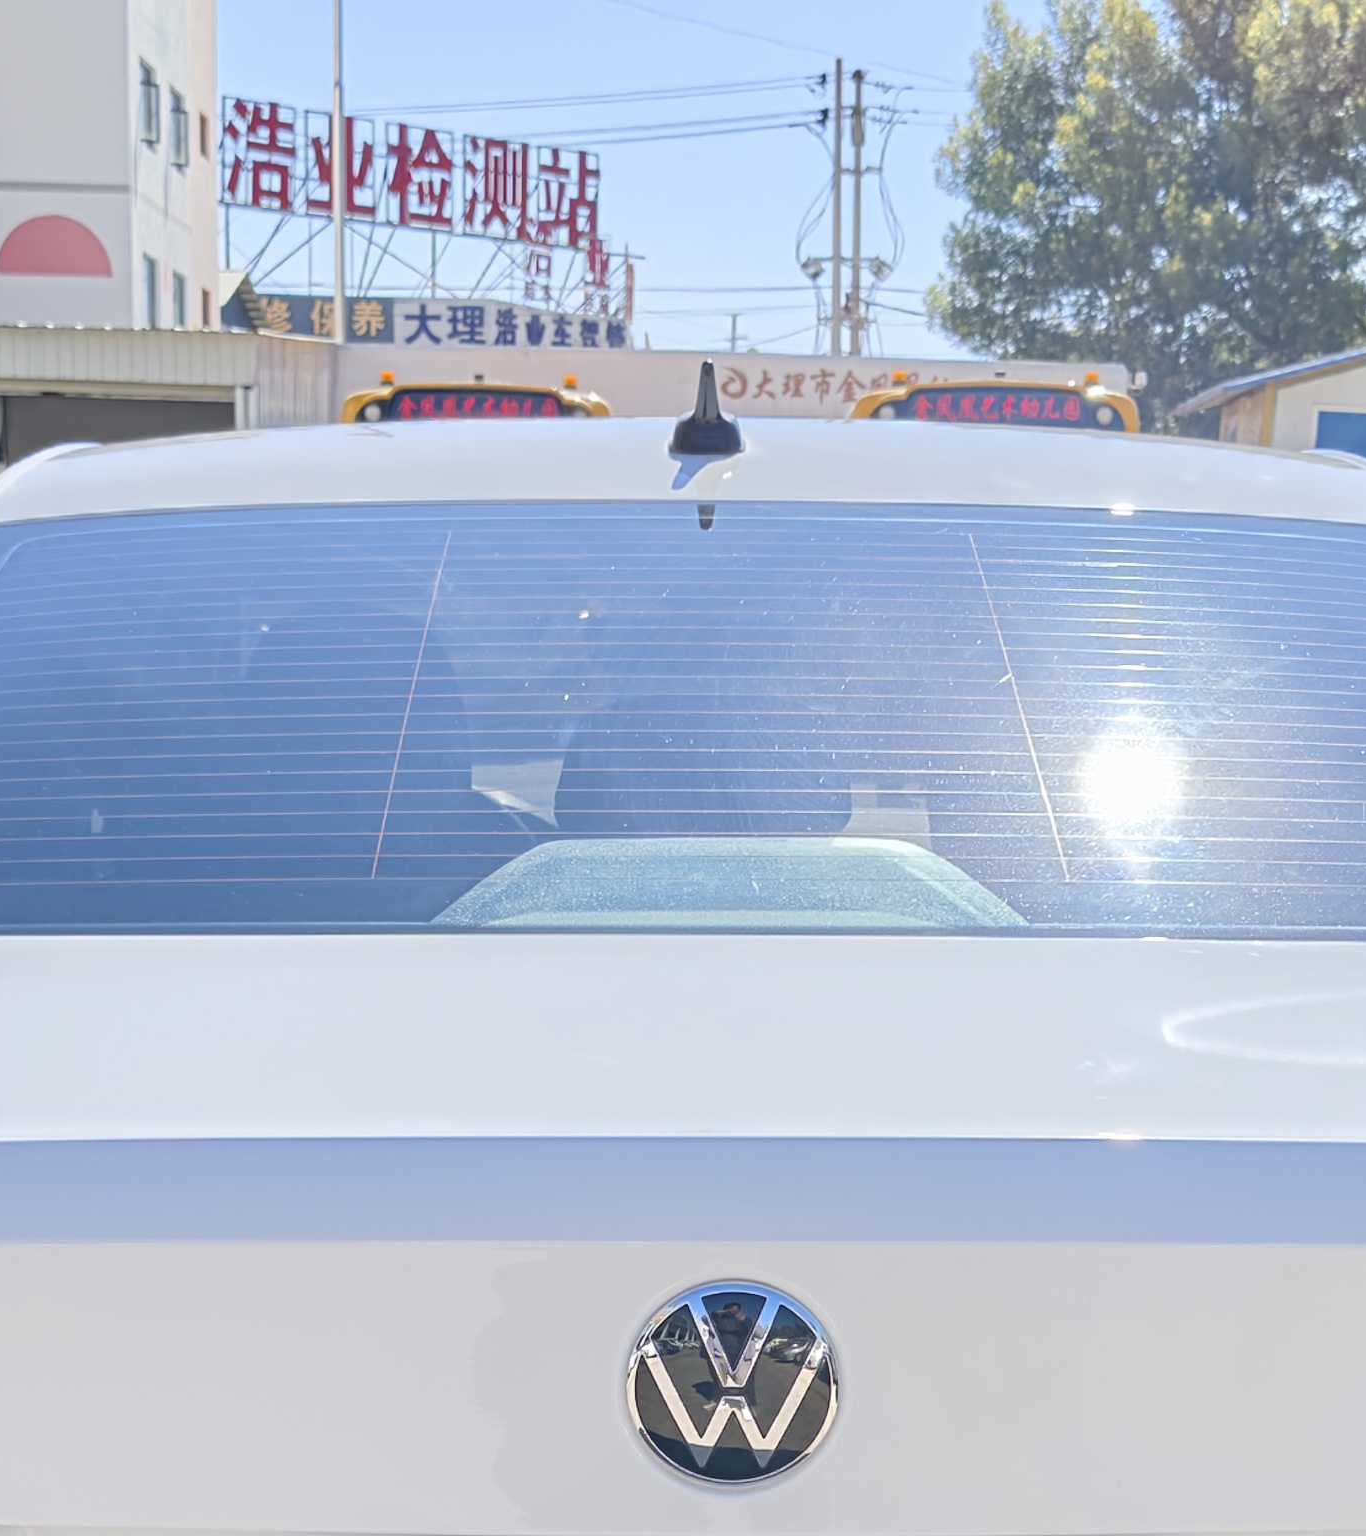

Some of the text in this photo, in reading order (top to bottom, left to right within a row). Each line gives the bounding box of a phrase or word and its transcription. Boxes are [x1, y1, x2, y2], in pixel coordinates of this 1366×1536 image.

[224, 97, 600, 248] 浩业检测站
